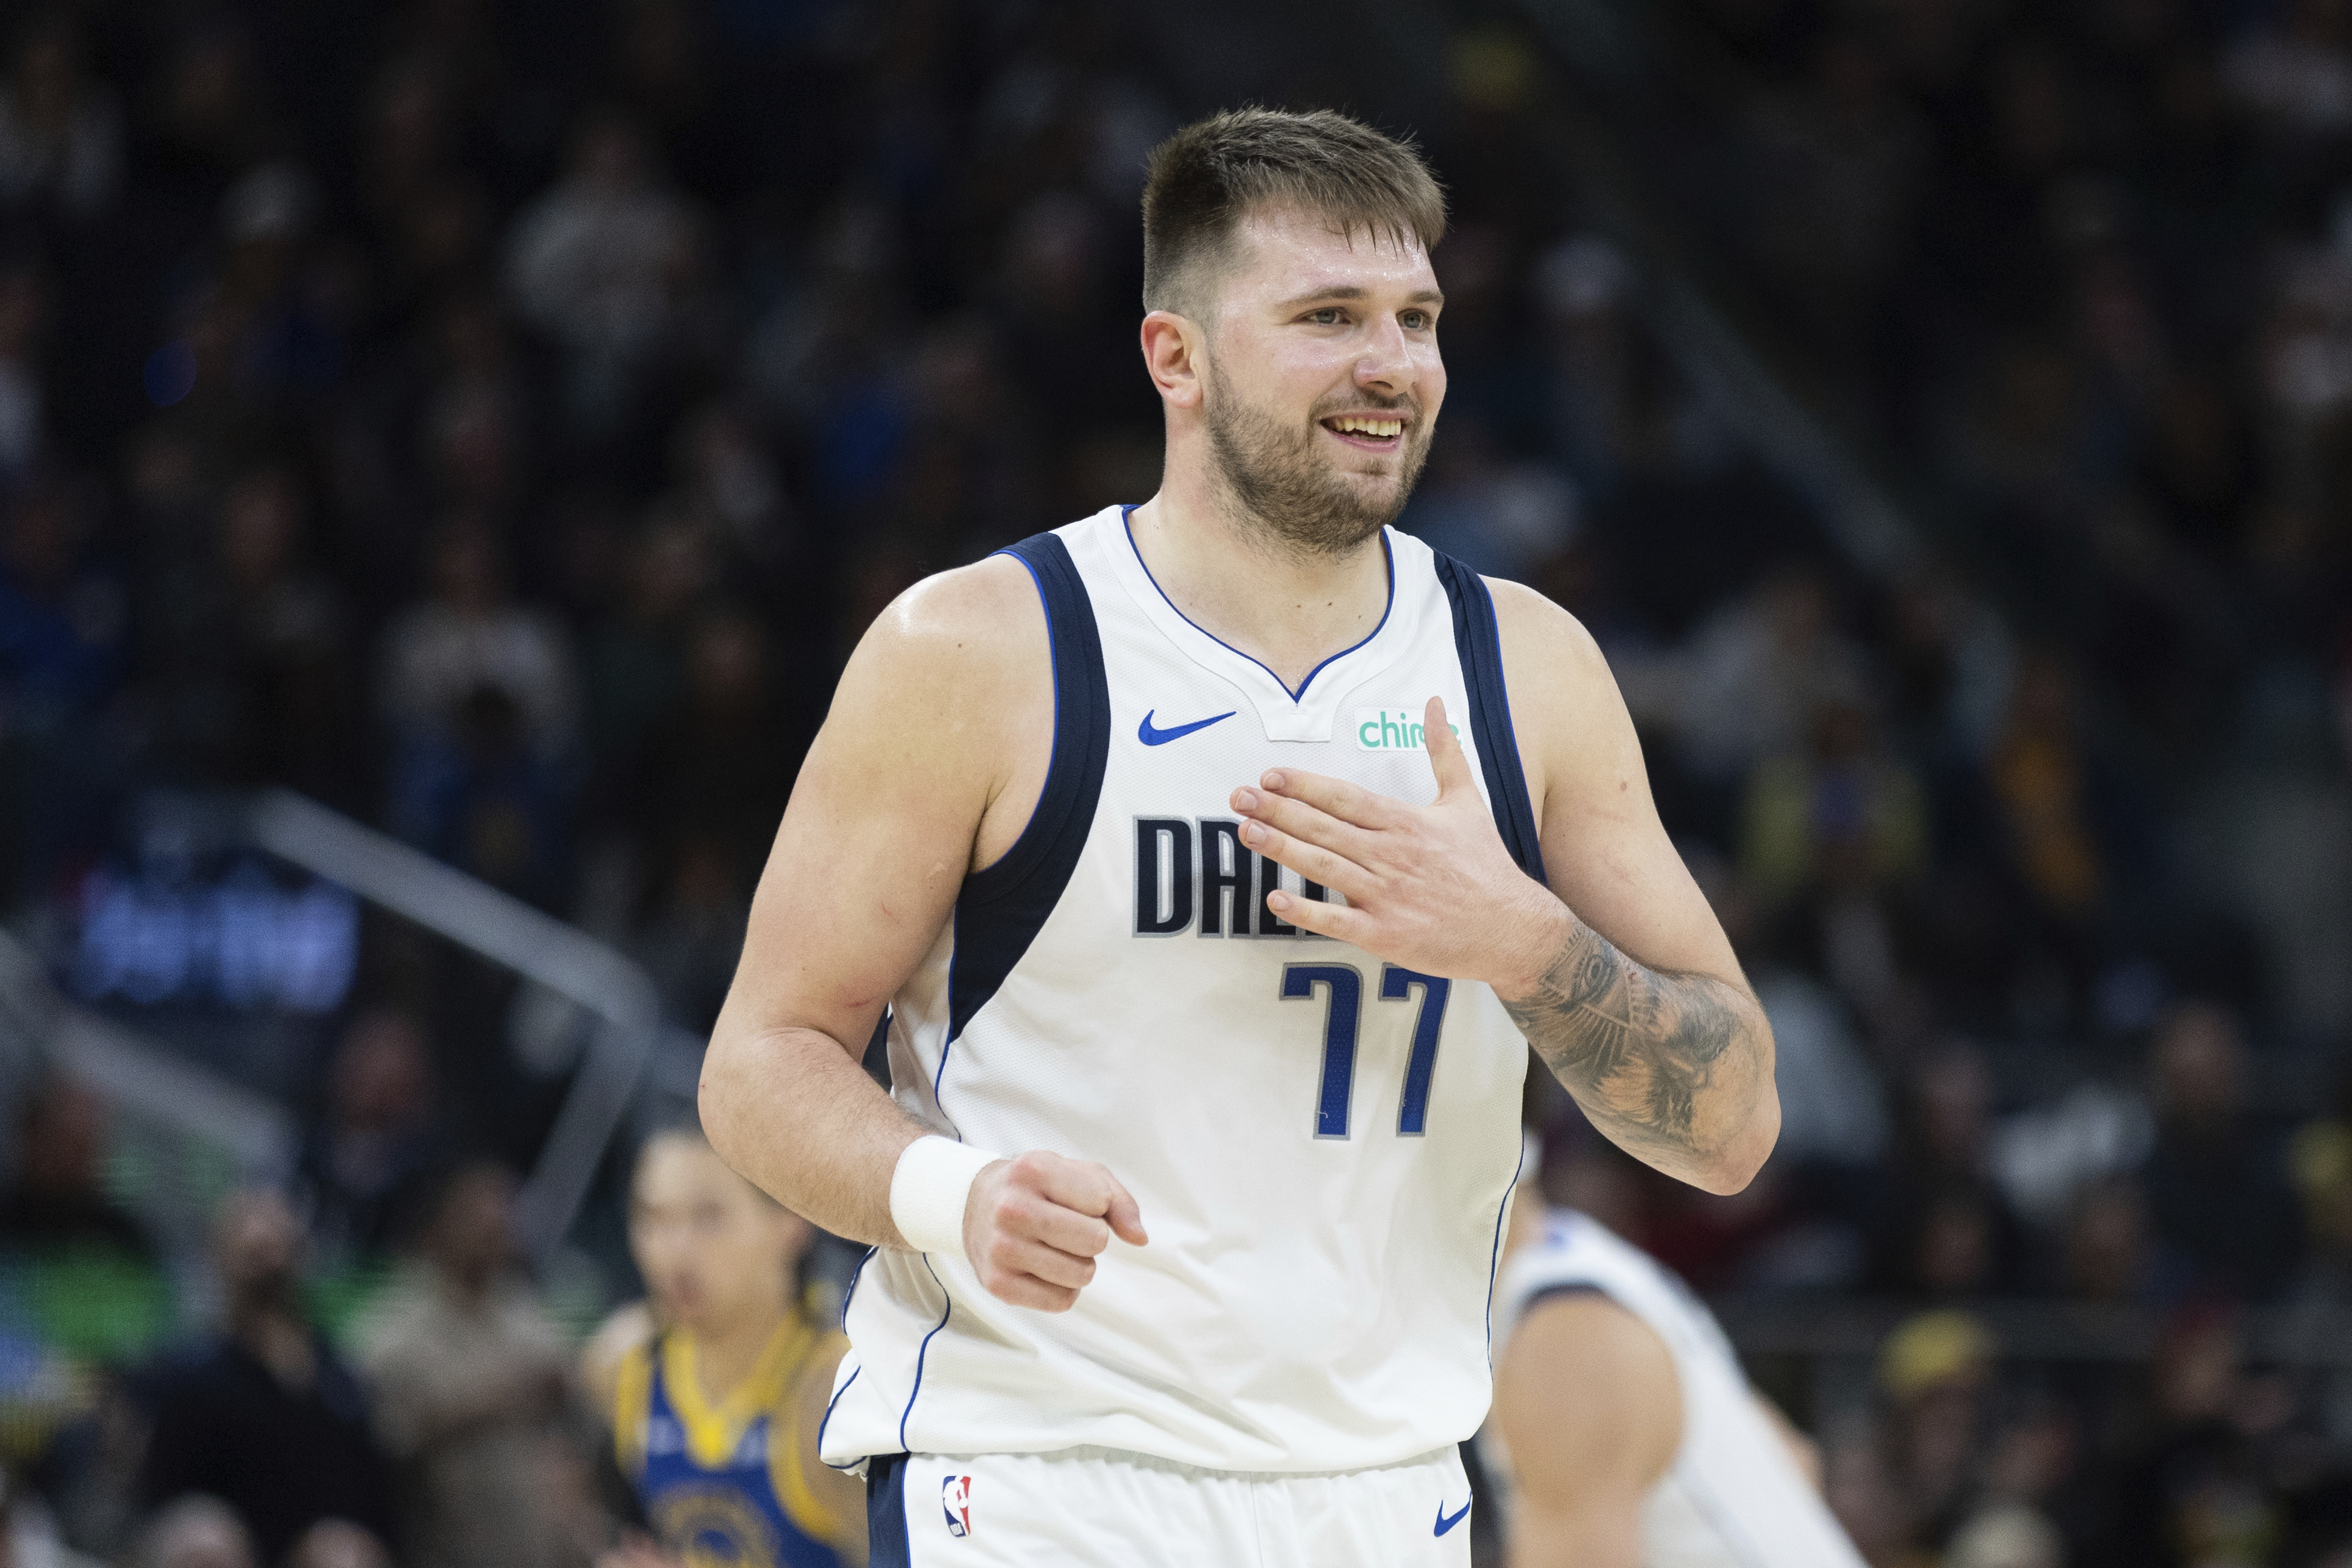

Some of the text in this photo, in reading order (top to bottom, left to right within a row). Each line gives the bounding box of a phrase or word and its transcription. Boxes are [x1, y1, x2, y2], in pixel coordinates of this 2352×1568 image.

[1359, 711, 1462, 748] chi
[1132, 814, 1348, 941] DAL
[1279, 962, 1453, 1141] 77
